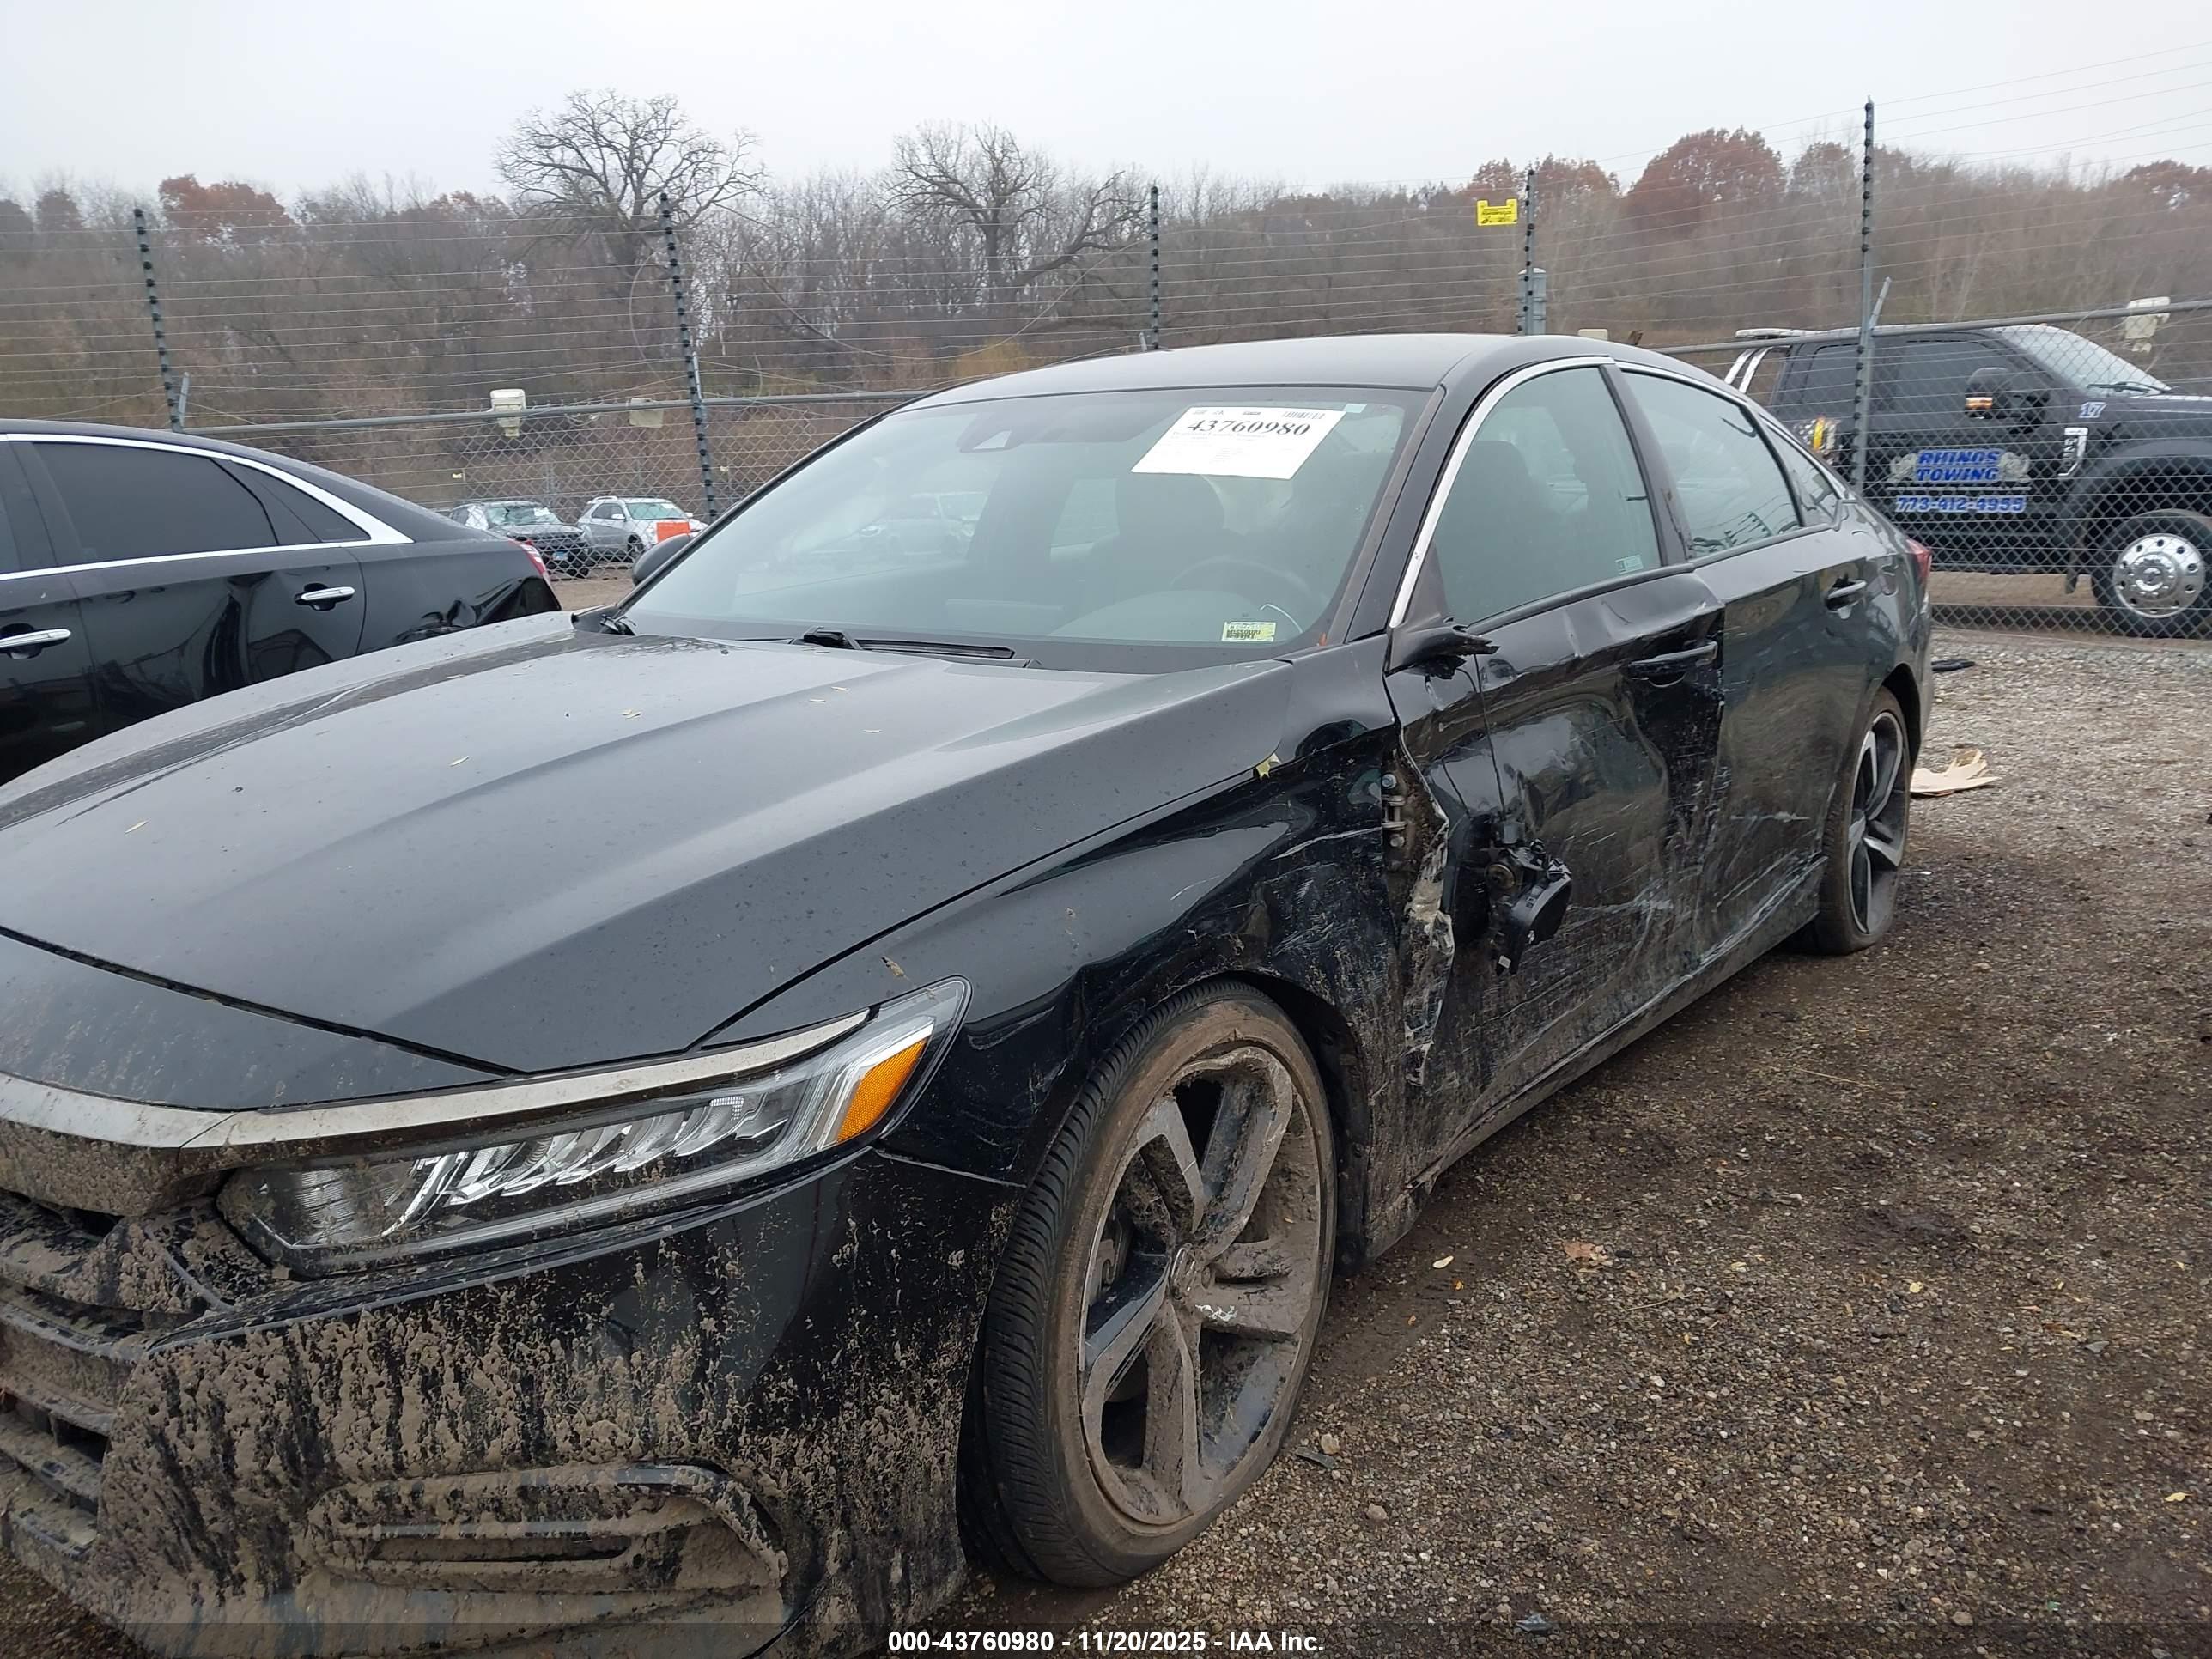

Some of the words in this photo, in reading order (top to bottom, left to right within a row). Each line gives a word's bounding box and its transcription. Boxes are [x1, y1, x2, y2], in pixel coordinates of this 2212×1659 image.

[1187, 419, 1311, 436] 43760980
[1918, 450, 2001, 465] RHINOS
[1917, 467, 2000, 481] TOWING
[1897, 495, 2026, 512] 773-412-4955
